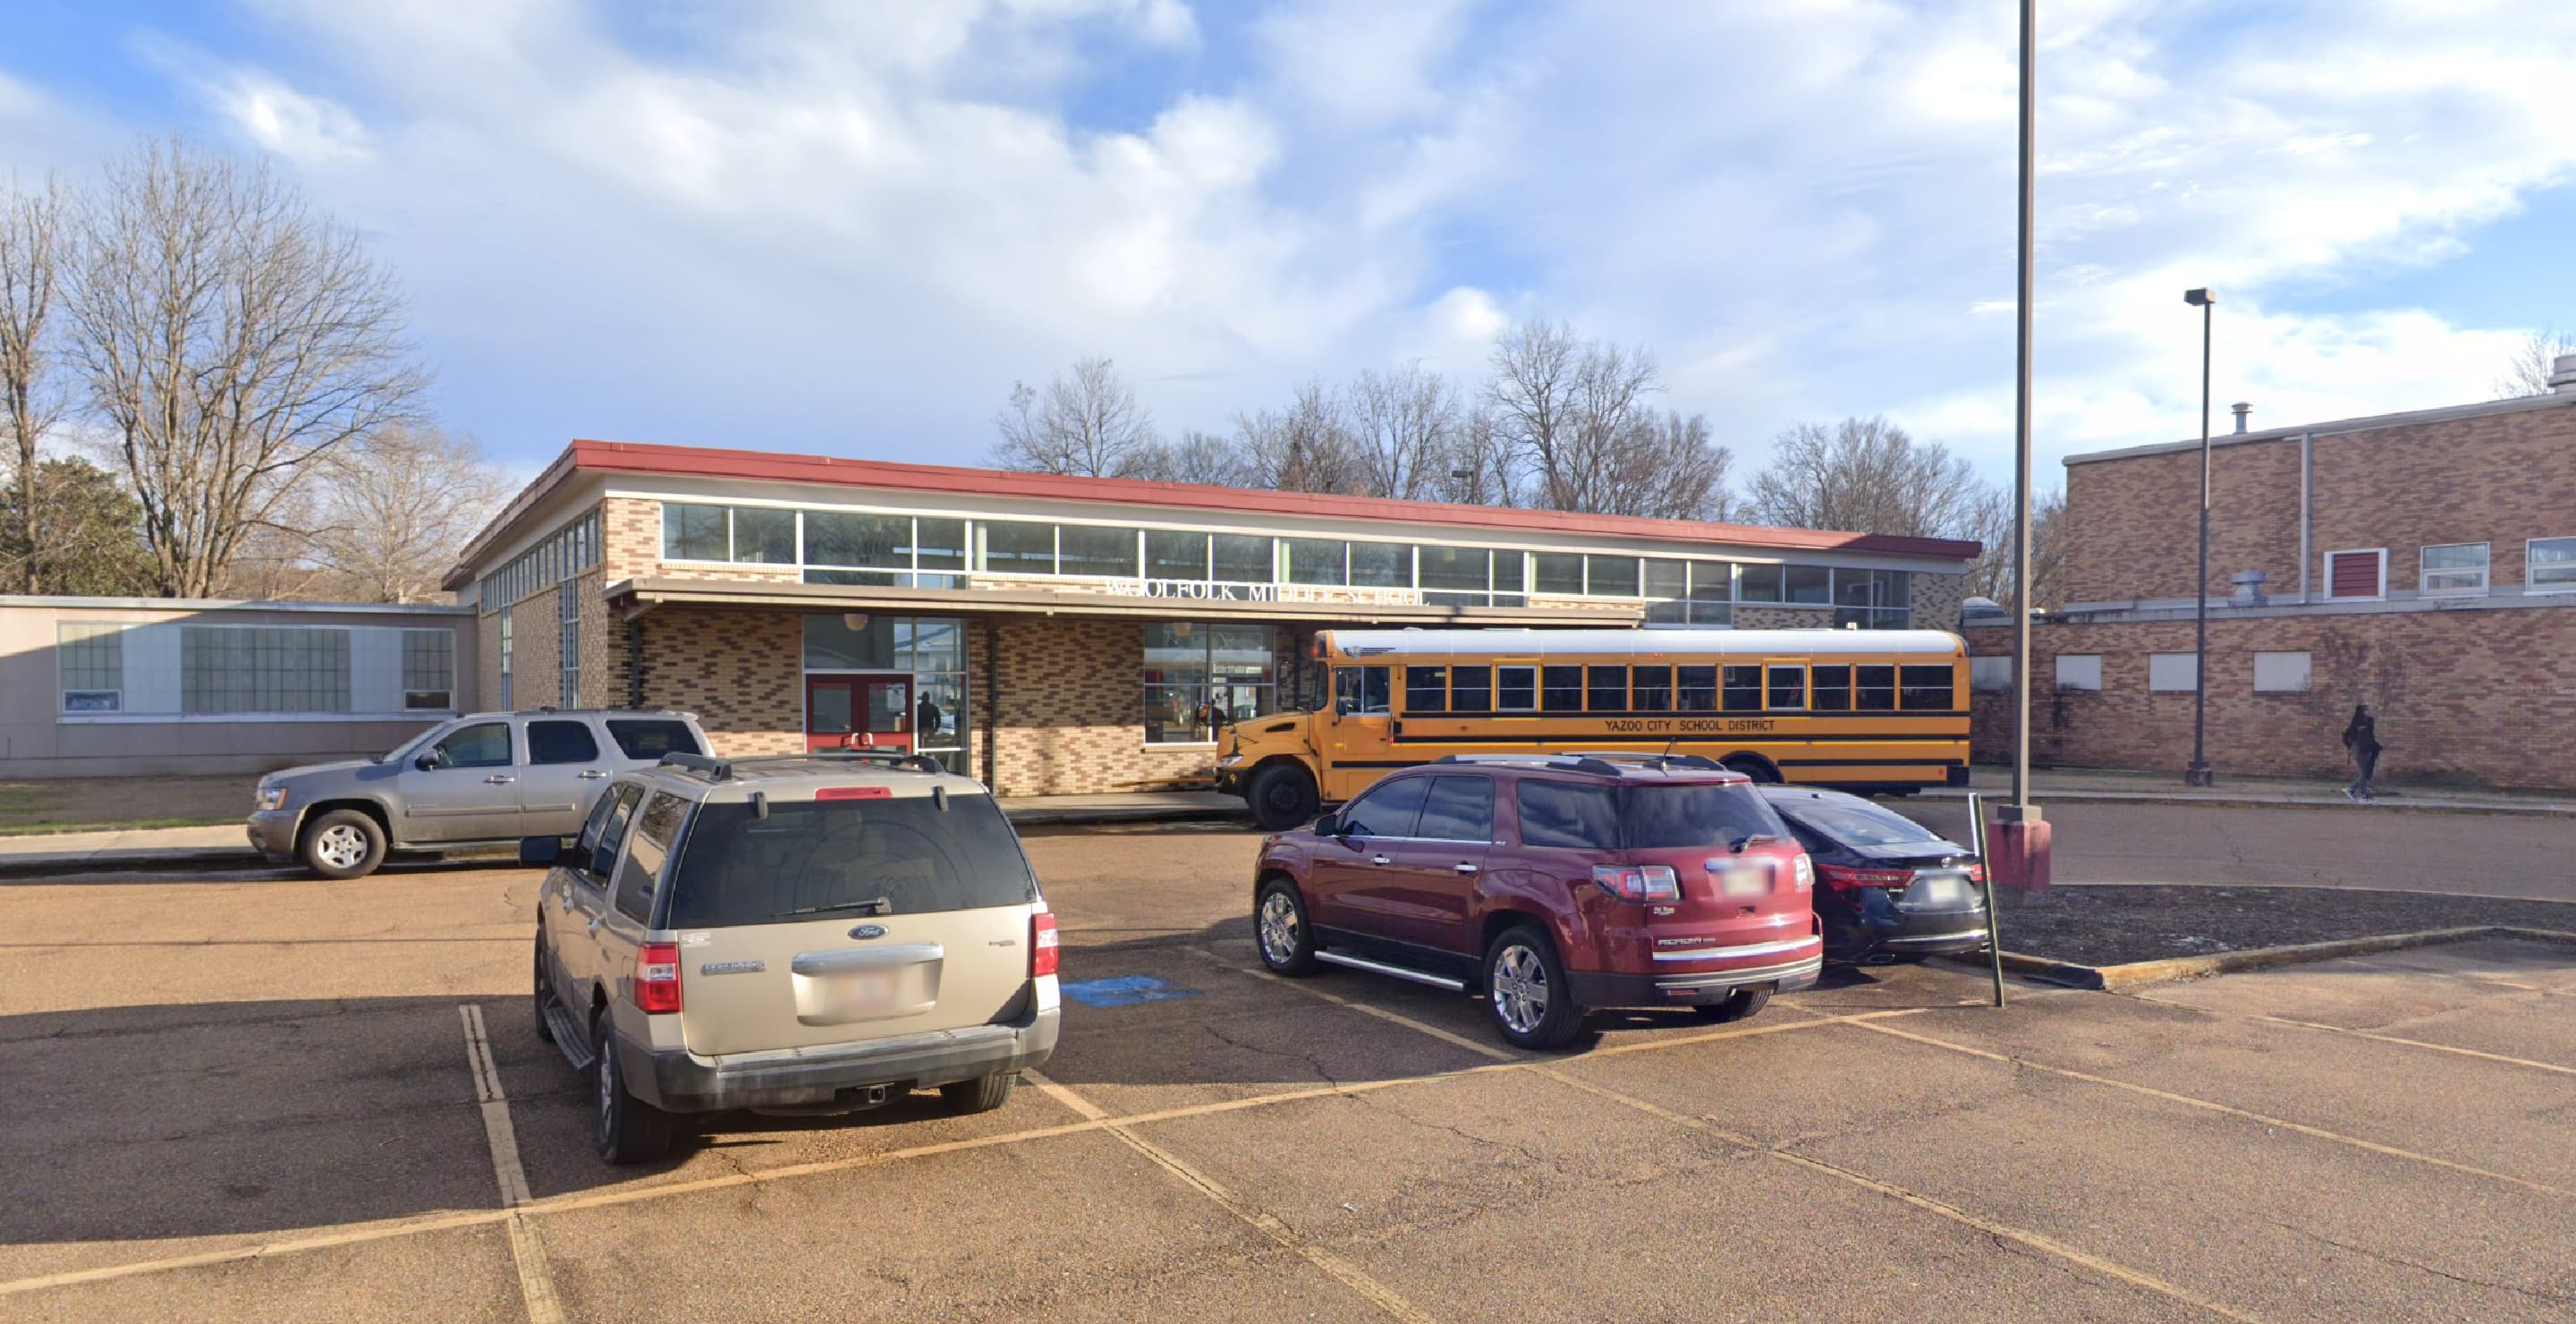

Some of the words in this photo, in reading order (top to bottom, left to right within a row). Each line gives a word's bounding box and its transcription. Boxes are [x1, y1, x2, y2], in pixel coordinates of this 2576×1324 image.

[1106, 579, 1238, 601] WOOLFOLK
[1606, 720, 1643, 732] YAZOO
[1647, 720, 1672, 732] CITY
[1679, 720, 1722, 732] SCHOOL
[1728, 720, 1775, 732] DISTRICT
